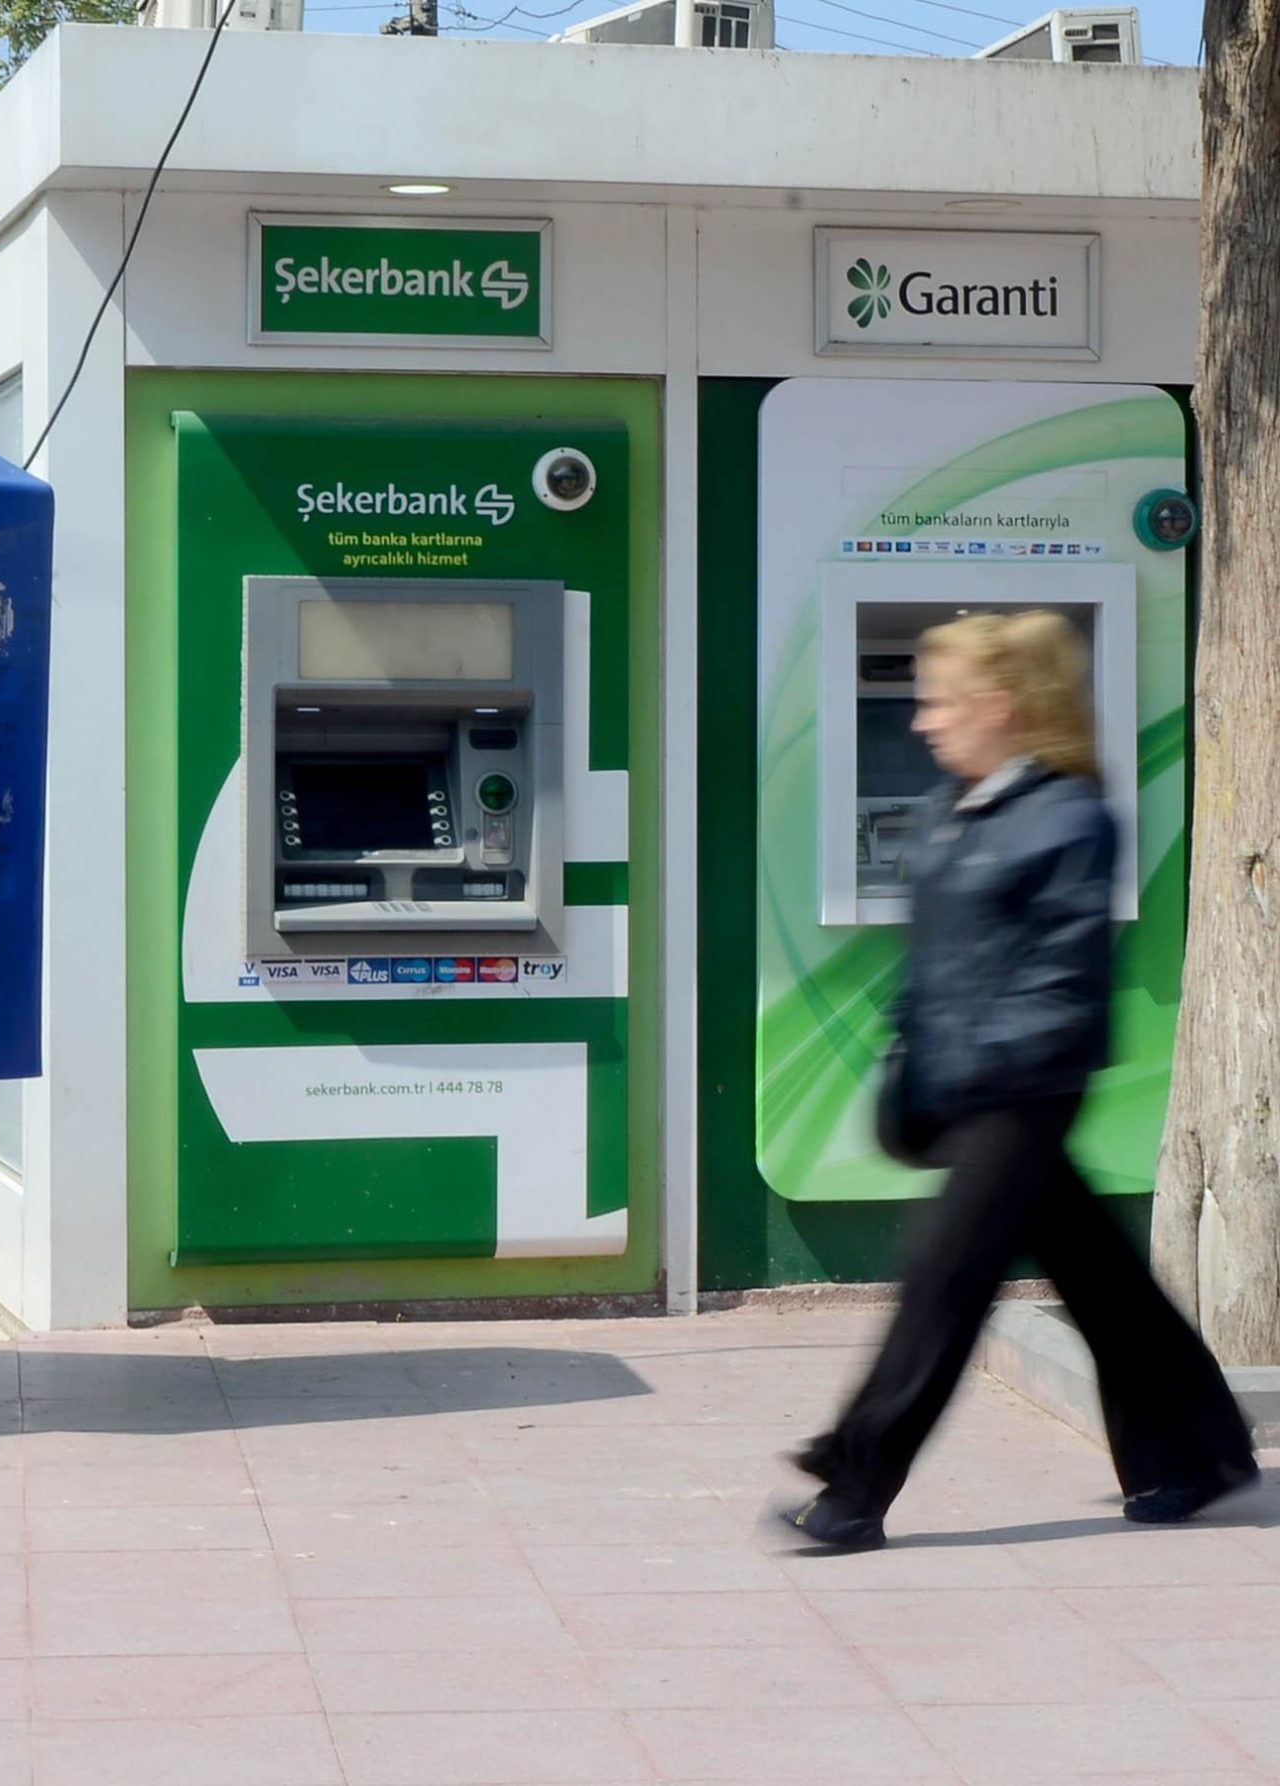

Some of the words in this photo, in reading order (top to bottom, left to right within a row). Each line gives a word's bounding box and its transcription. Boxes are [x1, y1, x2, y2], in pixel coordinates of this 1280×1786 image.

[275, 256, 474, 304] Şekerbank
[899, 272, 1057, 317] Garanti
[297, 482, 467, 522] Şekerbank
[881, 513, 910, 527] tüm
[914, 512, 992, 528] bankaların
[996, 513, 1070, 531] kartlarıyla
[328, 533, 358, 546] tüm
[362, 532, 407, 546] banka
[411, 532, 483, 547] kartlarına
[343, 552, 413, 568] ayrıcalıklı
[417, 552, 468, 566] hizmet
[267, 966, 298, 978] VISA
[311, 965, 340, 976] VISA
[359, 969, 389, 982] PLUS
[523, 960, 563, 980] troy
[305, 1081, 425, 1096] sekerbank.com.tr
[436, 1081, 463, 1095] 444
[467, 1081, 484, 1095] 78
[487, 1080, 504, 1094] 78
